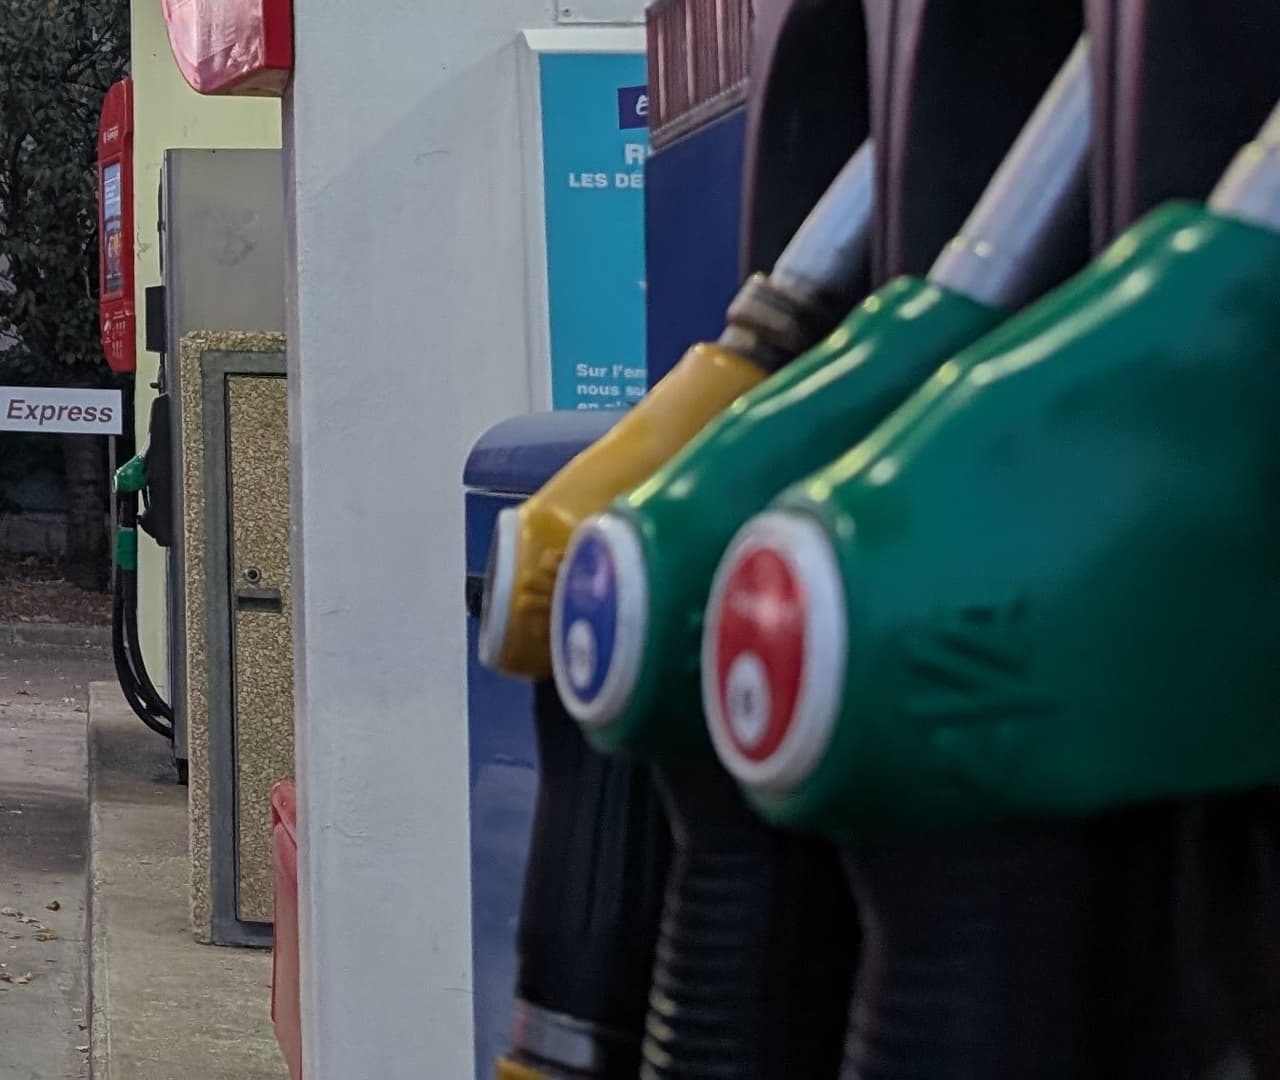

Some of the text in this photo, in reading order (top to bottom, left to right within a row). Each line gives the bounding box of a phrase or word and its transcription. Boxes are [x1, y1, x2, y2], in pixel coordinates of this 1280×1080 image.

[568, 172, 608, 189] LES
[576, 363, 607, 377] Sur
[576, 384, 620, 396] nous
[6, 399, 113, 425] Express
